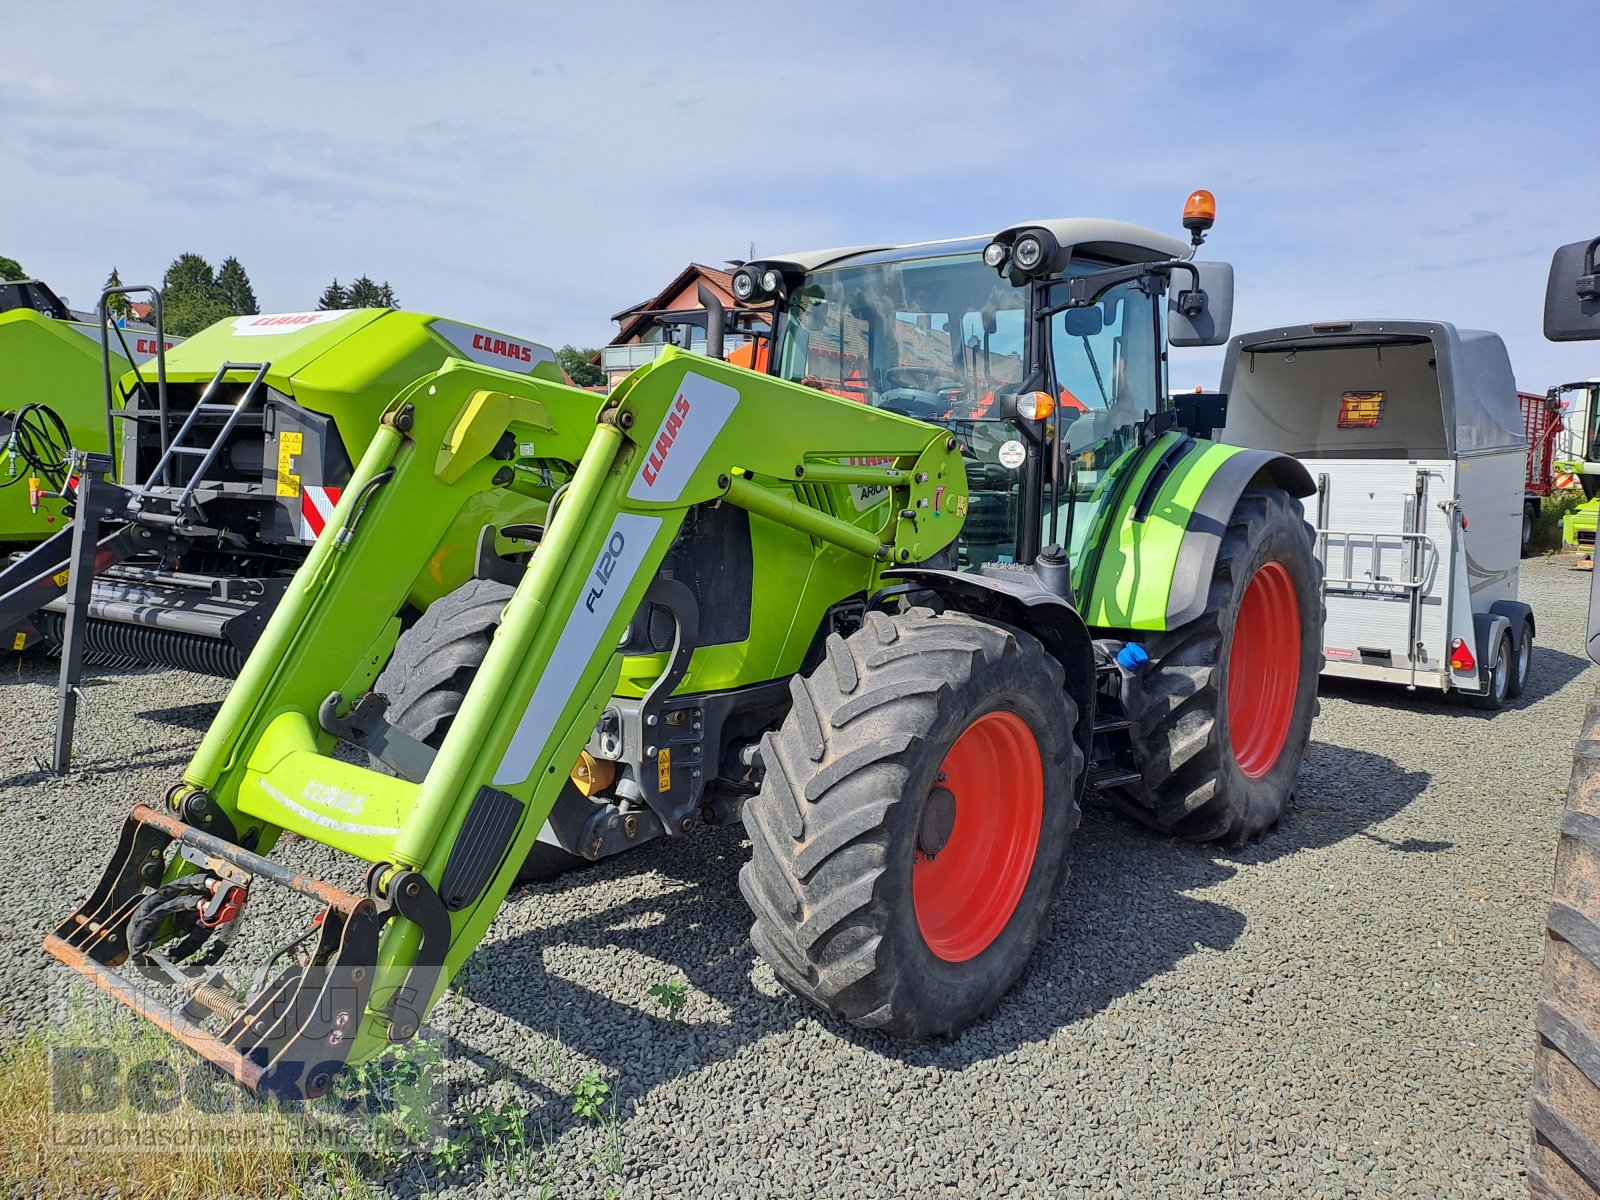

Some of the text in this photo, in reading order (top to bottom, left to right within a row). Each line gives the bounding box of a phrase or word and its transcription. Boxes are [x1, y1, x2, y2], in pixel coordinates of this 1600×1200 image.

[249, 314, 322, 326] CLAAS
[136, 338, 174, 354] CL
[472, 333, 532, 363] CLAAS
[641, 393, 691, 488] CLAAS
[585, 531, 625, 614] FL 120
